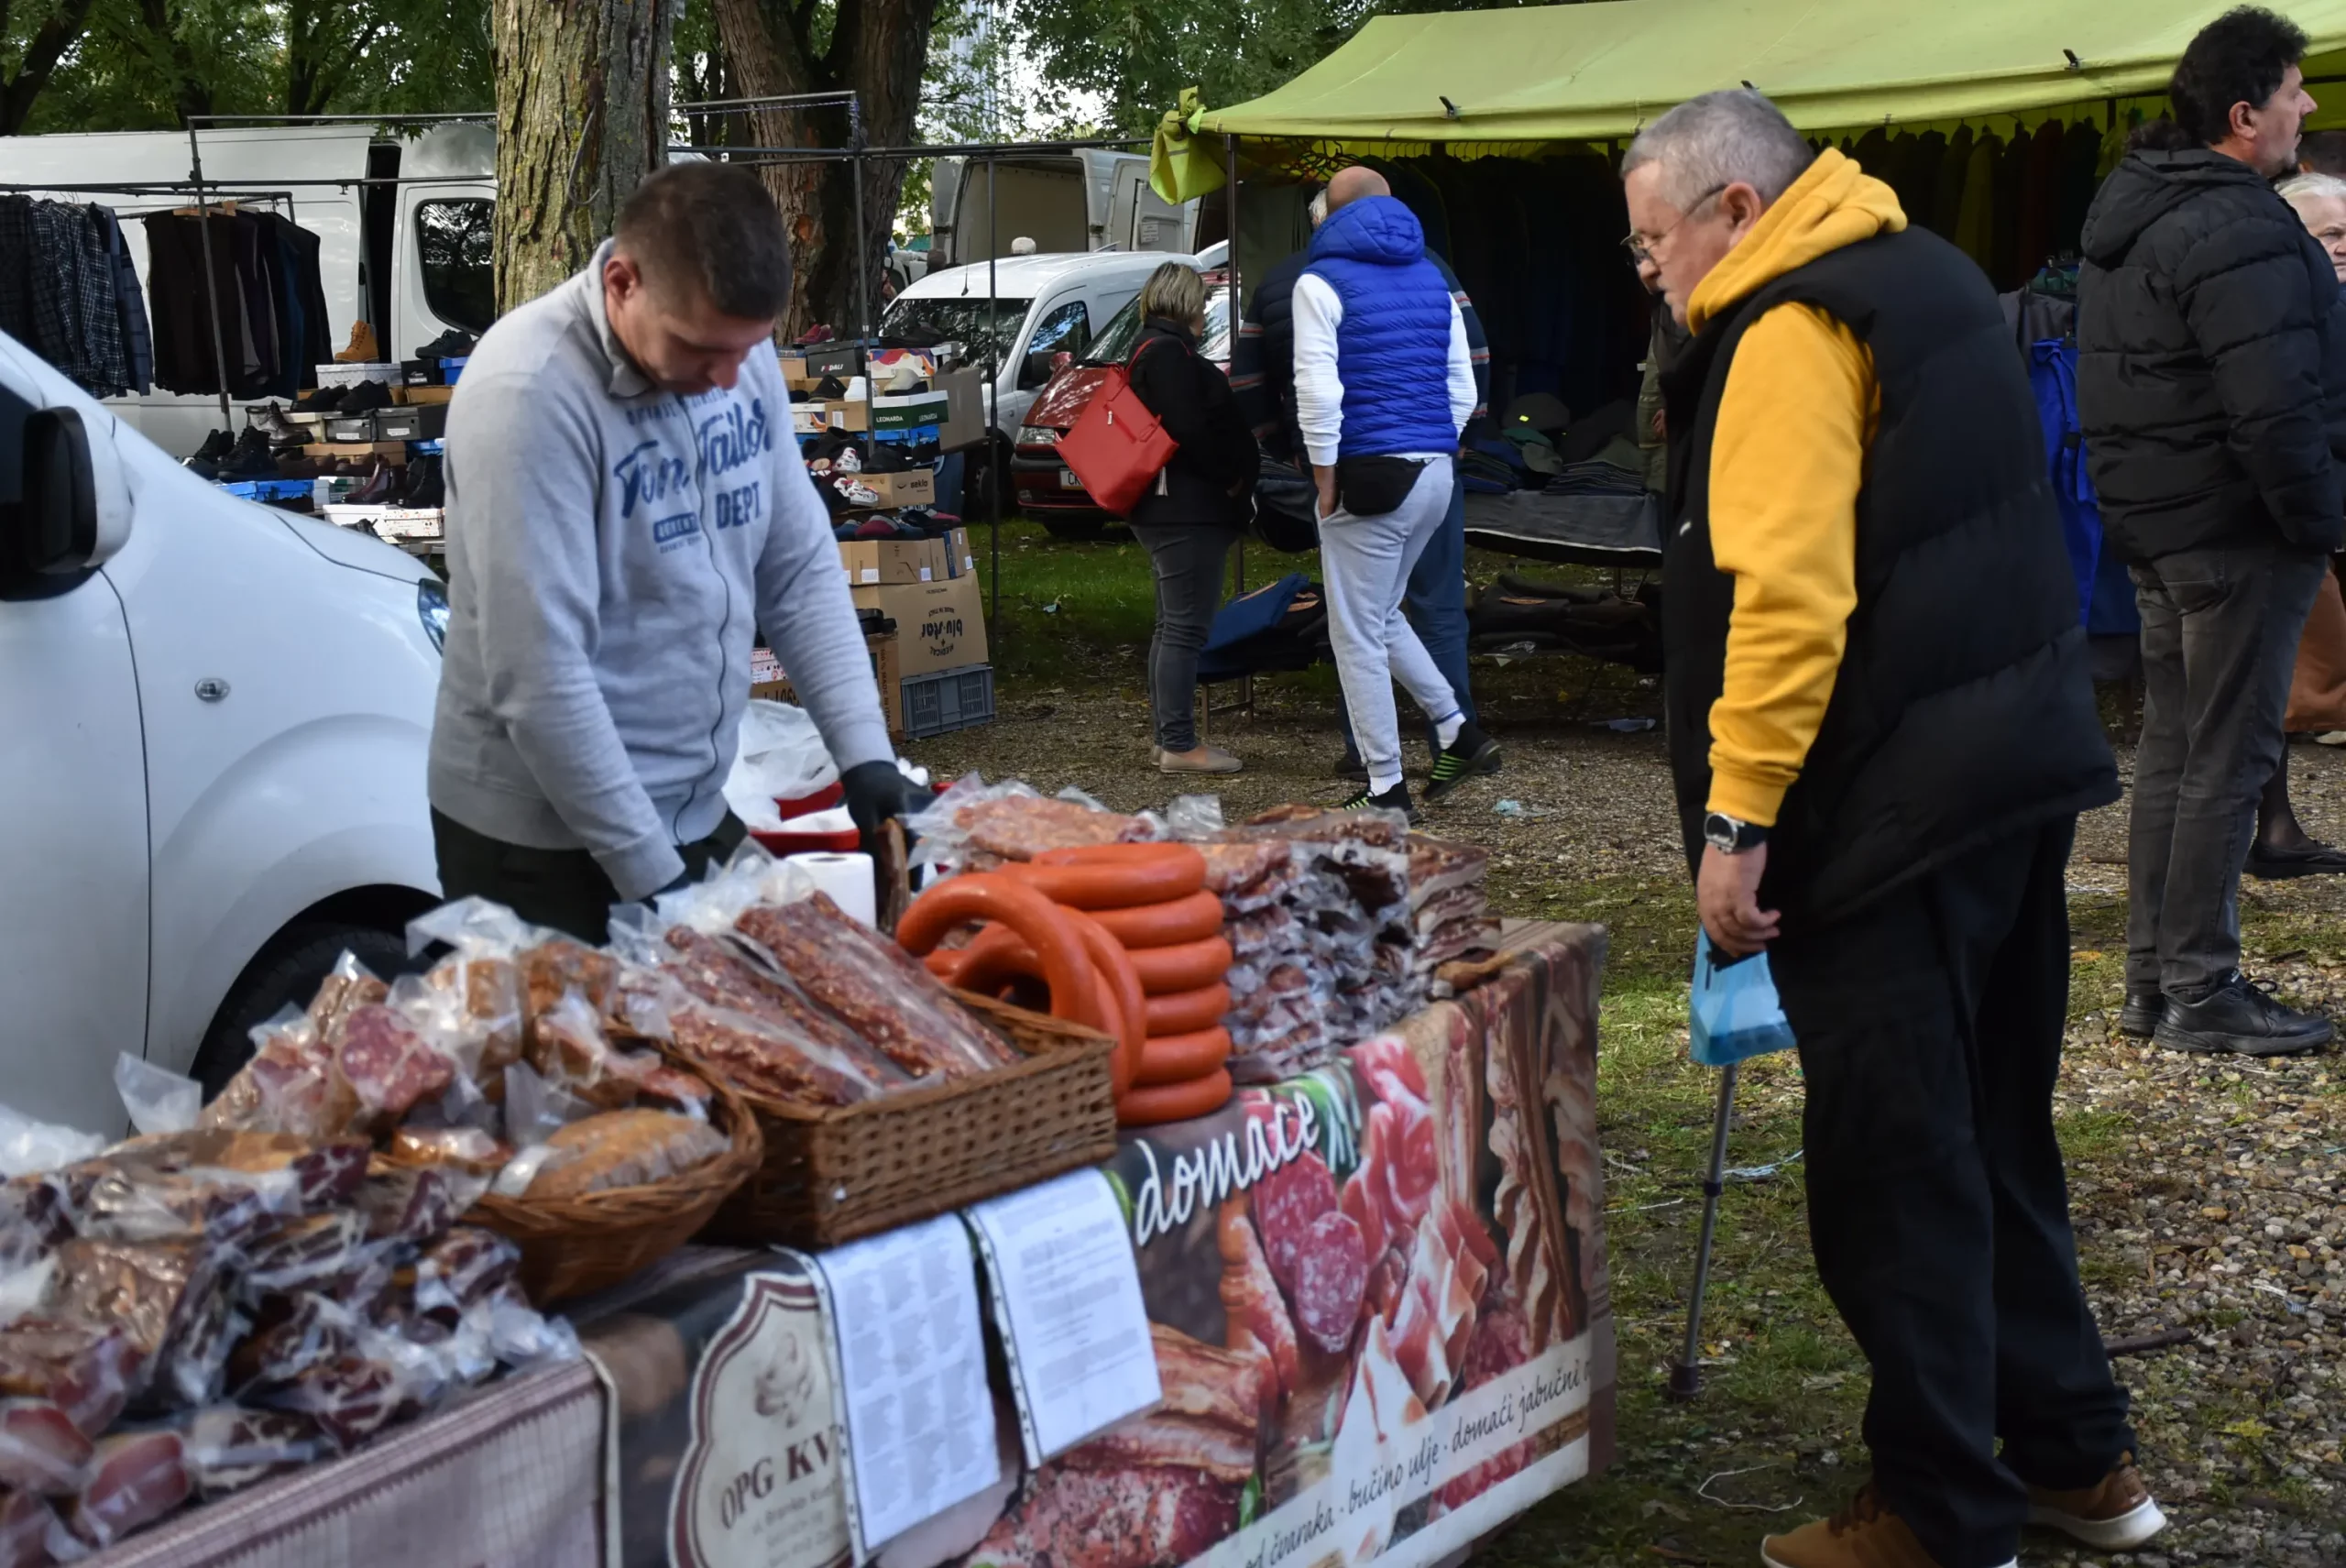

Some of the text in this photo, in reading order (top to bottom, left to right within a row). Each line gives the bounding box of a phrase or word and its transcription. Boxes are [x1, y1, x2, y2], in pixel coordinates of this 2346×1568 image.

[876, 415, 904, 423] LEONARDA
[716, 481, 760, 530] DEPT
[881, 672, 889, 696] MADE
[1409, 1435, 1439, 1486] ulje
[1452, 1392, 1515, 1453] domaći
[720, 1455, 775, 1530] OPG
